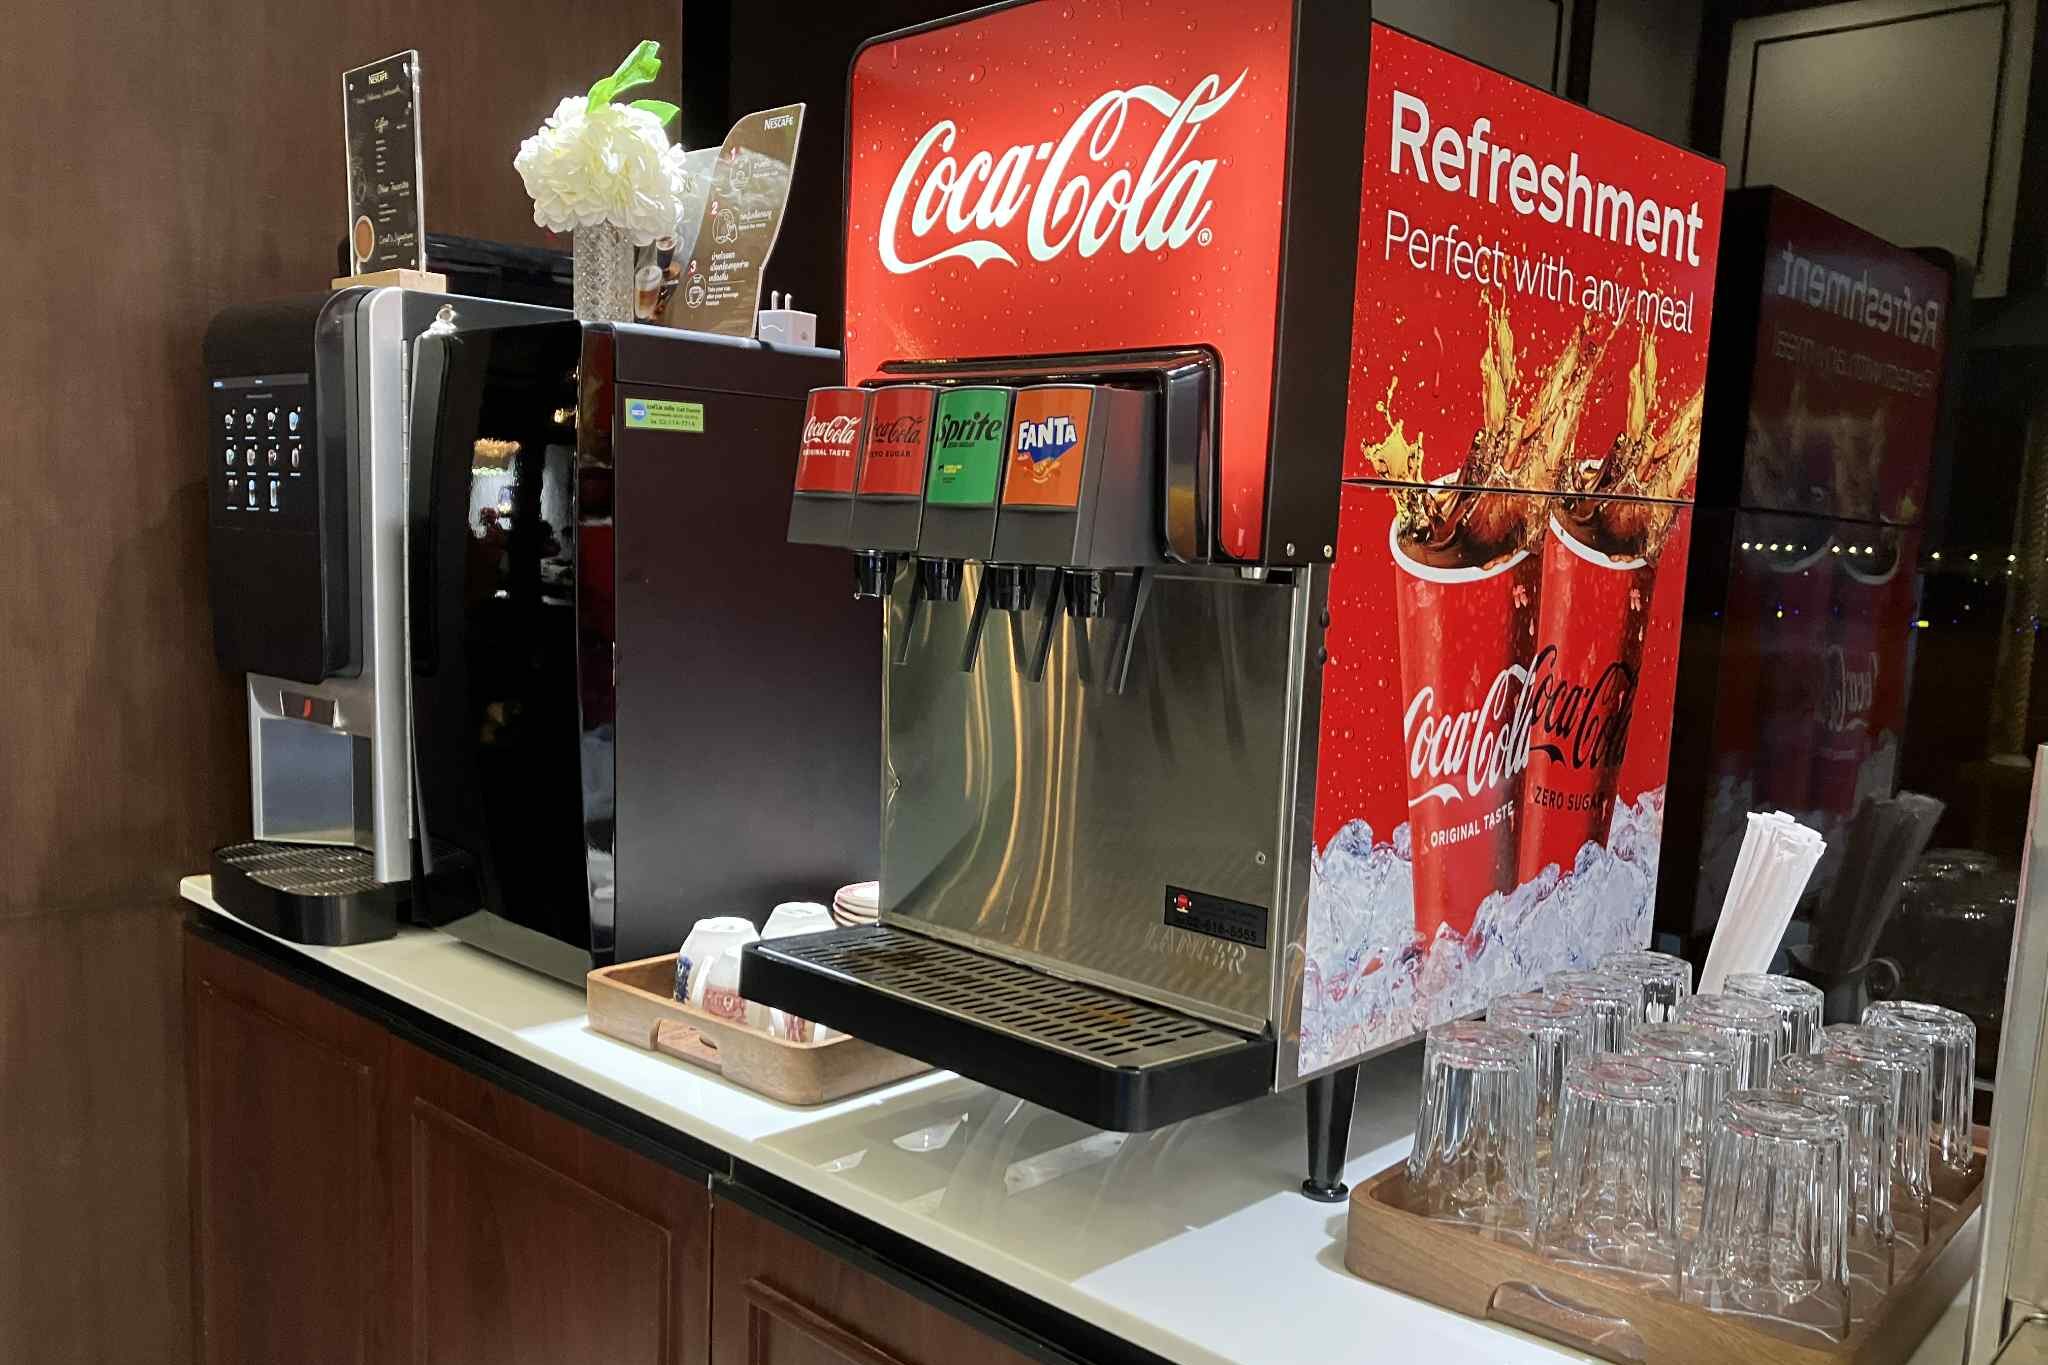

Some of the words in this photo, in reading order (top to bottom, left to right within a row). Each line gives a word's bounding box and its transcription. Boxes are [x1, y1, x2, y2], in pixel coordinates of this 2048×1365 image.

[878, 66, 1249, 274] Coca-Cola
[1390, 89, 1704, 268] Refreshment
[1385, 209, 1505, 289] Perfect
[1513, 252, 1575, 305] with
[1582, 274, 1631, 327] any
[1636, 288, 1695, 335] meal
[936, 411, 1003, 448] Sprite
[1017, 416, 1078, 451] FANTA
[1534, 786, 1564, 810] ZERO
[1430, 819, 1481, 849] ORIGINAL
[1483, 800, 1514, 830] TASTE
